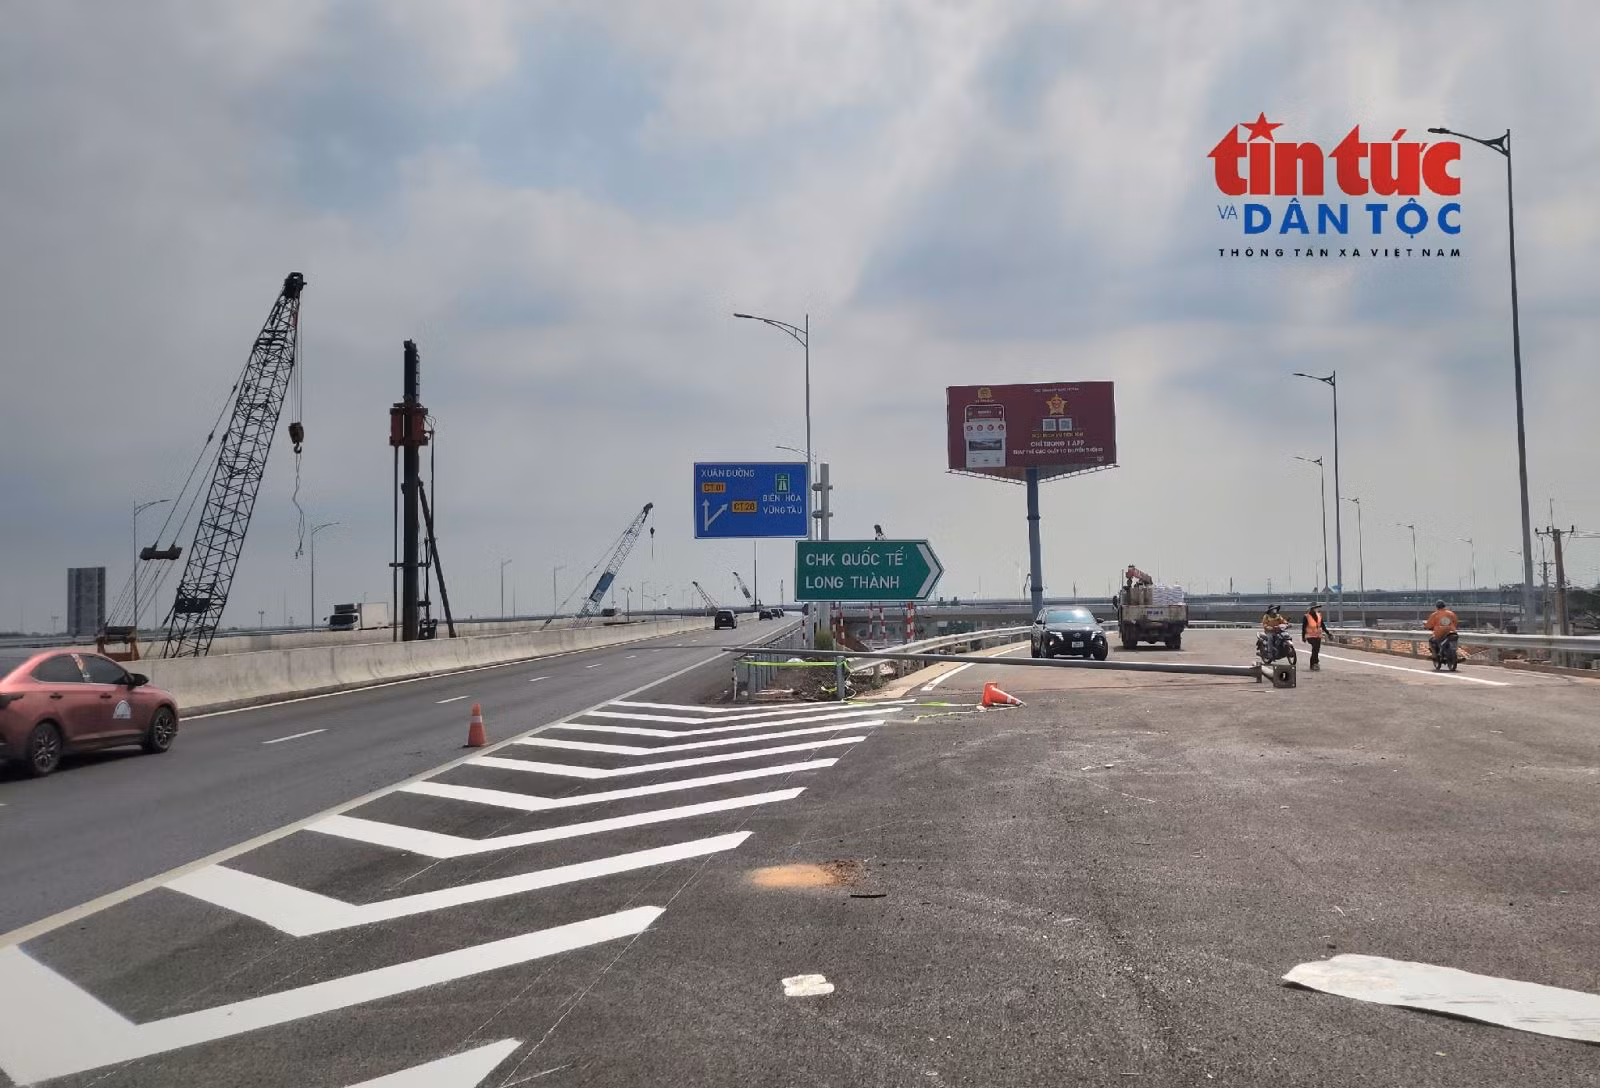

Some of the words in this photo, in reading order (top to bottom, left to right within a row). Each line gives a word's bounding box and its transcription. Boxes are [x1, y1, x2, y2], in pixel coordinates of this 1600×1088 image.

[805, 553, 835, 566] CHK
[841, 546, 881, 566] QUỐC
[885, 546, 904, 566] TẾ
[805, 576, 844, 589] LONG
[850, 572, 900, 589] THÀNH
